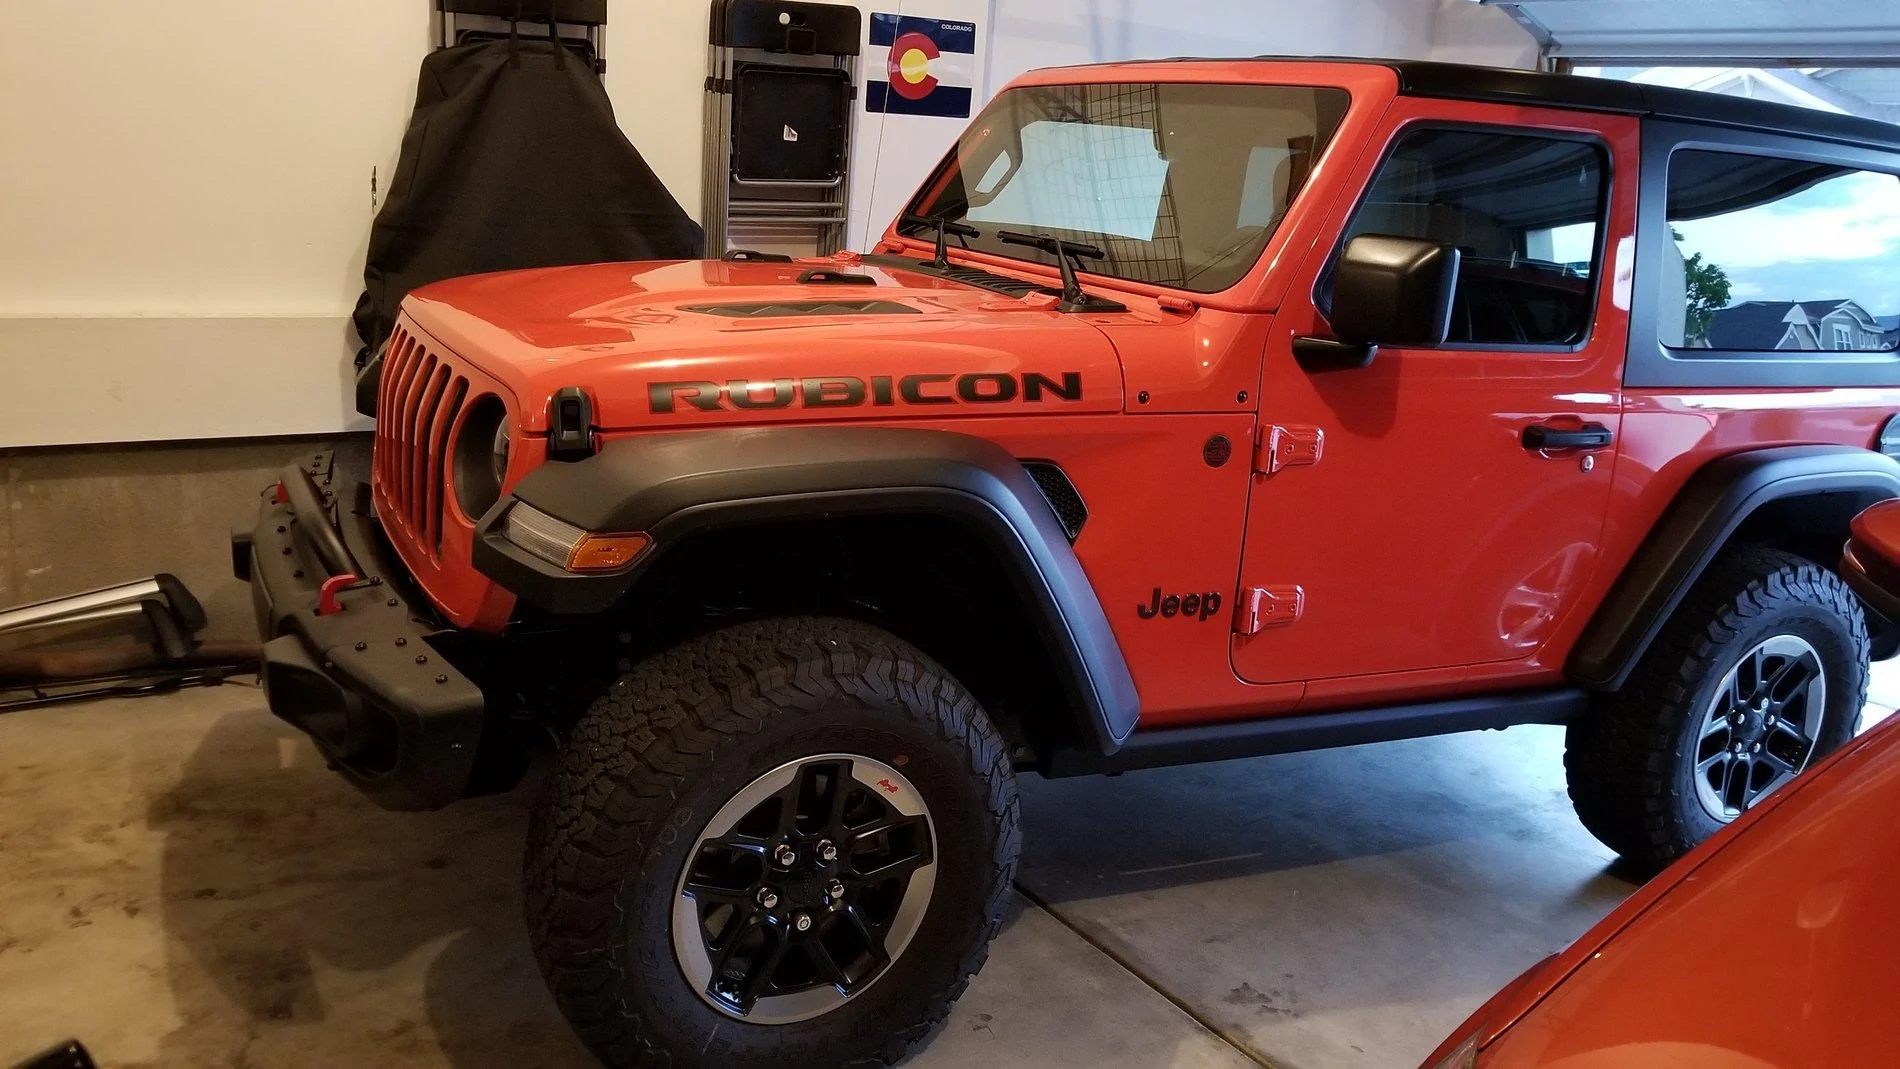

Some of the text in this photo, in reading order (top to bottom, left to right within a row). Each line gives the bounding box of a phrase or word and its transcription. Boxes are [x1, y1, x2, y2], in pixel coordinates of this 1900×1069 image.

[941, 24, 973, 32] COLORADO
[647, 371, 1082, 414] RUBICON
[1137, 588, 1222, 621] Jeep
